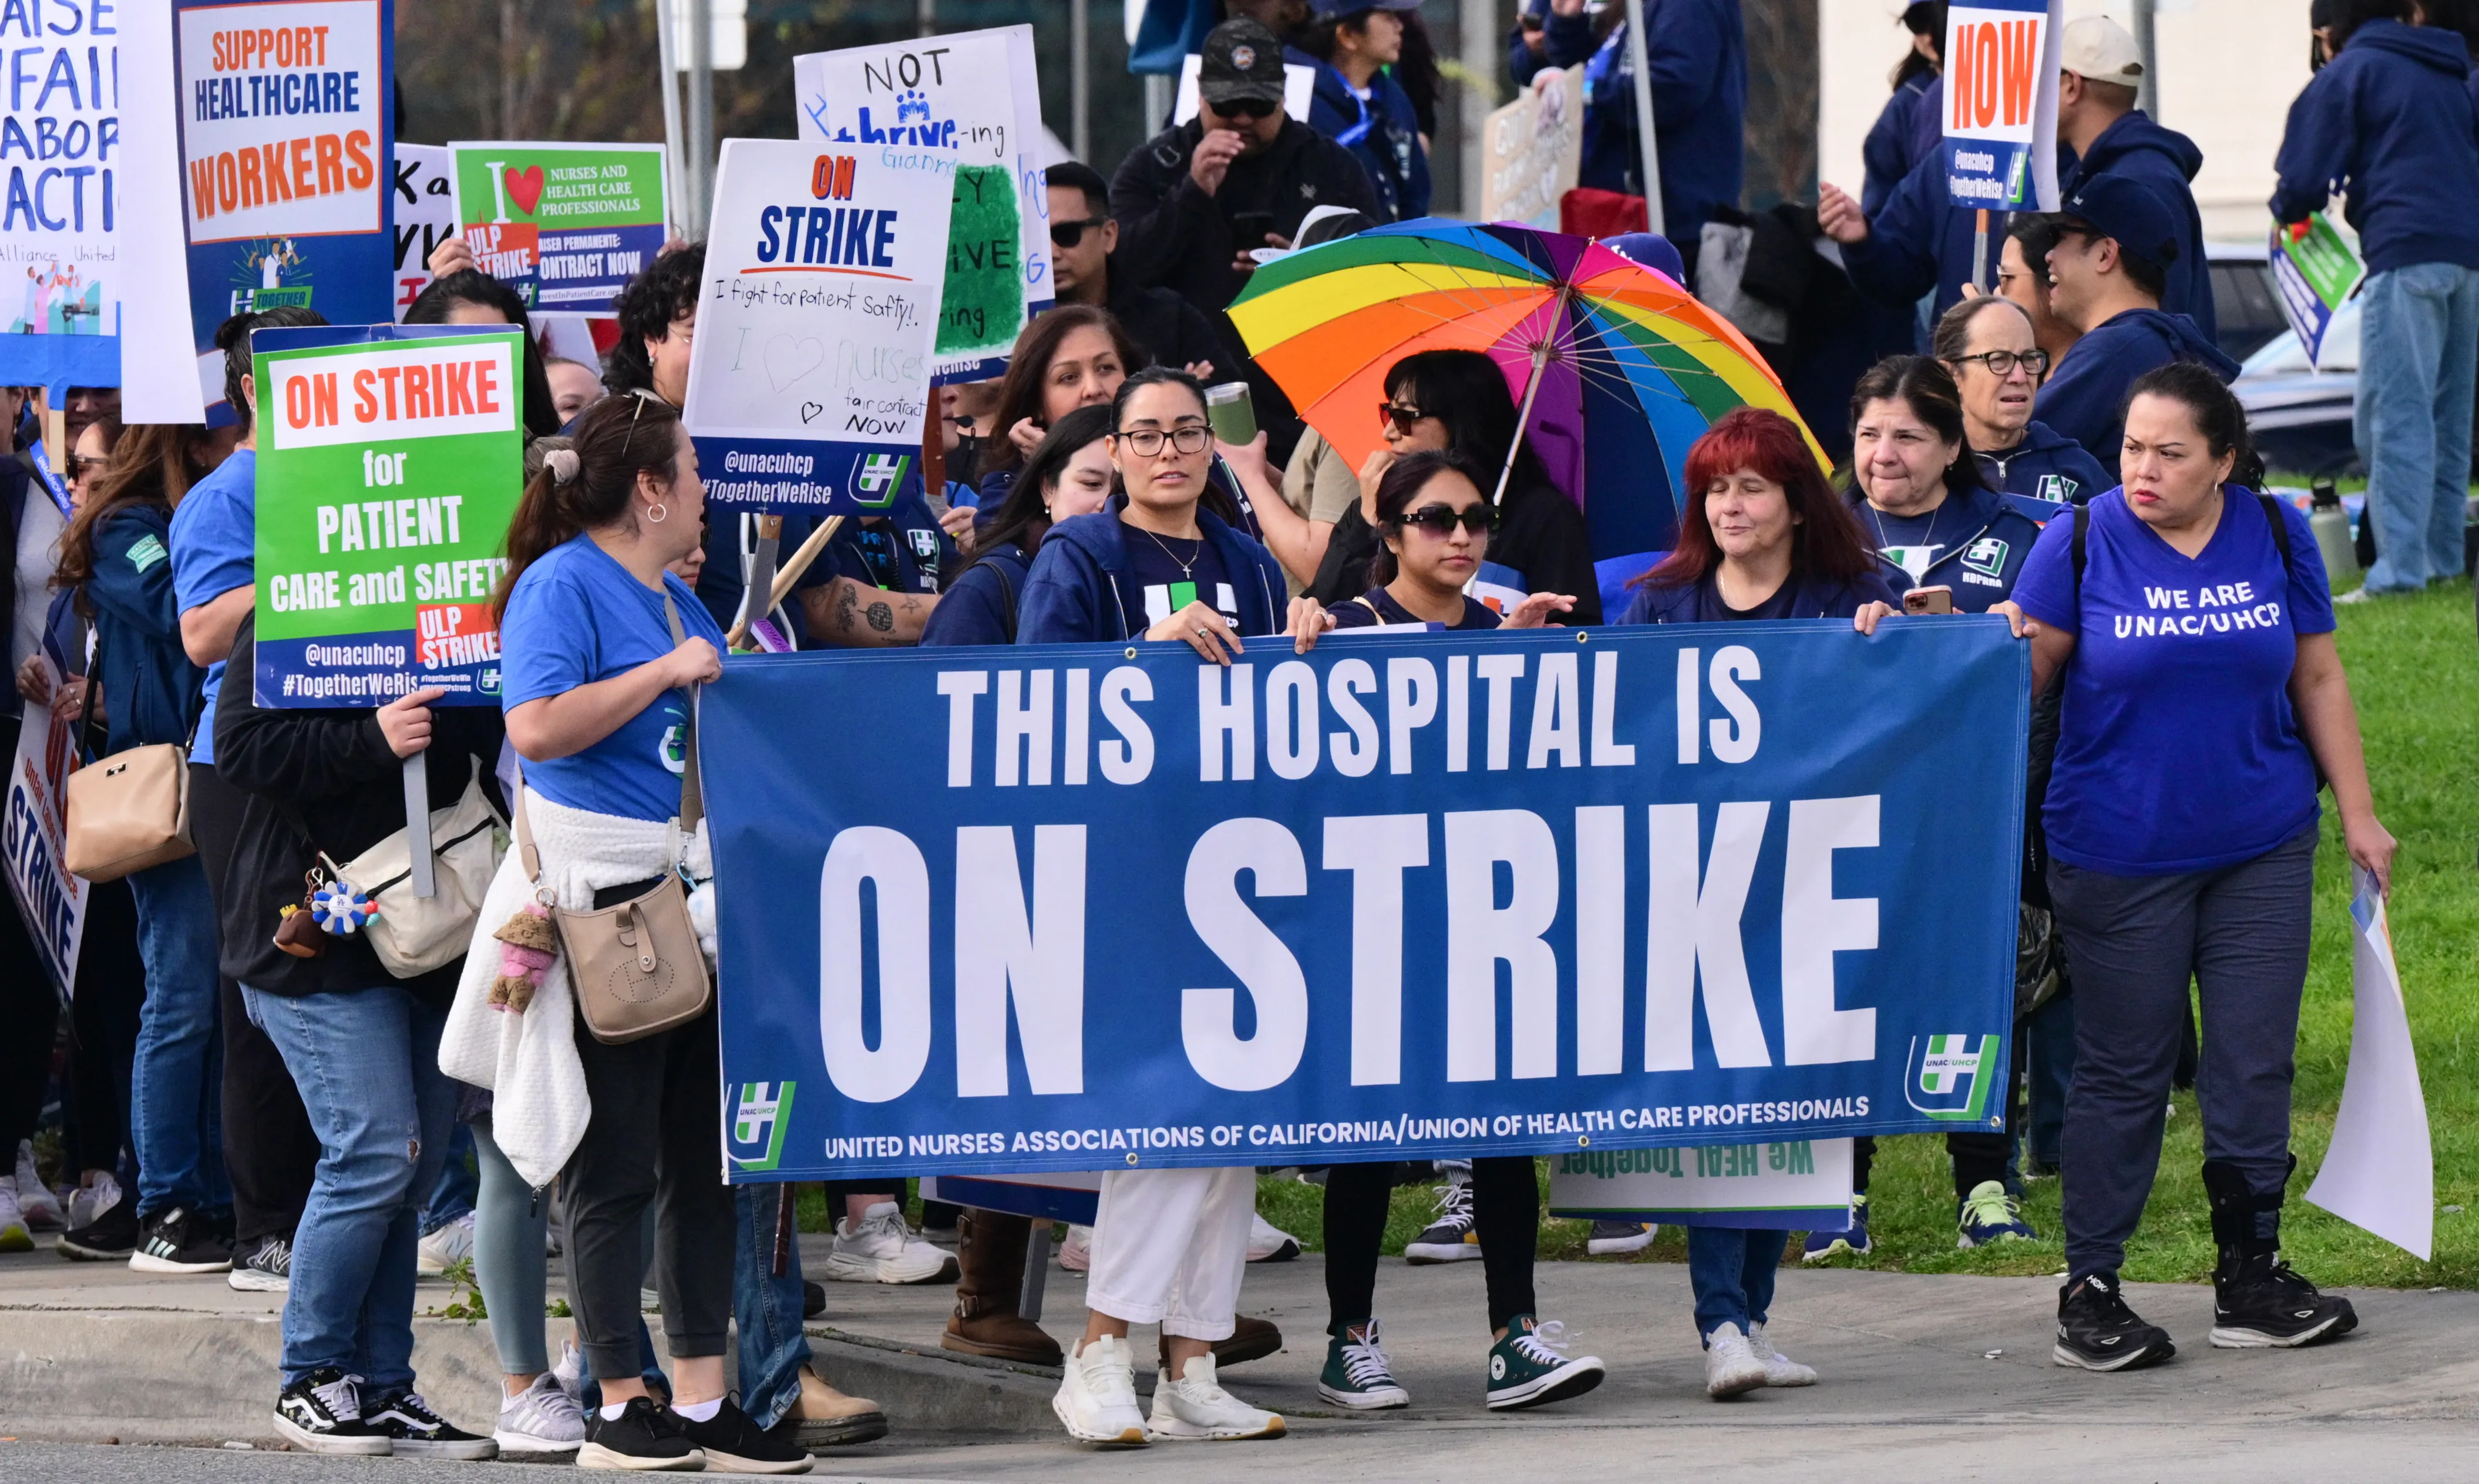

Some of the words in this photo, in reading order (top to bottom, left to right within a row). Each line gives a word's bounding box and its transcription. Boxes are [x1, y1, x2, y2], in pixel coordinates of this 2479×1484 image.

[213, 26, 328, 72] SUPPORT
[0, 46, 117, 112] FAI
[864, 48, 950, 93] NOT
[1953, 19, 2037, 130] NOW
[195, 71, 359, 122] HEALTHCARE
[190, 129, 375, 222] WORKERS
[550, 166, 598, 181] NURSES
[601, 165, 628, 178] AND
[812, 154, 856, 201] ON
[1955, 149, 1994, 174] @unacuhcp
[3, 166, 120, 232] ACTI
[485, 161, 511, 224] I
[541, 198, 640, 216] PROFESSIONALS
[546, 184, 597, 199] HEALTH
[599, 182, 632, 196] CARE
[74, 245, 115, 262] United
[466, 225, 502, 256] ULP
[563, 234, 621, 251] PERMANENTE:
[757, 206, 897, 267] STRIKE
[471, 248, 533, 280] STRIKE
[607, 251, 641, 276] NOW
[257, 291, 306, 308] TOGETHER
[715, 280, 725, 299] I
[731, 279, 768, 308] fight
[773, 281, 796, 304] for
[731, 327, 752, 372] I
[285, 372, 339, 429] ON
[353, 359, 499, 423] STRIKE
[845, 386, 874, 410] fair
[877, 396, 927, 418] contract
[845, 413, 906, 435] NOW
[363, 450, 407, 487] for
[725, 450, 814, 477] @unacuhcp
[702, 479, 832, 504] #TogetherWeRise
[317, 495, 463, 553] PATIENT
[270, 570, 341, 613] CARE
[349, 566, 405, 607] and
[2143, 586, 2191, 610] WE
[2198, 581, 2255, 608] ARE
[419, 606, 462, 640] ULP
[2114, 603, 2280, 639] UNAC/UHCP
[305, 643, 405, 668] @unacuhcp
[422, 631, 501, 670] STRIKE
[936, 666, 1155, 788] THIS
[1198, 651, 1636, 782] HOSPITAL
[1677, 645, 1761, 765] IS
[25, 757, 44, 806] Unfair
[42, 797, 55, 844] Labor
[8, 785, 75, 981] STRIKE
[819, 825, 1088, 1103] ON
[1180, 794, 1882, 1092] STRIKE
[740, 1108, 776, 1116] UNAC/UHCP
[826, 1136, 903, 1159] UNITED
[909, 1132, 1005, 1156] NURSES
[1011, 1126, 1205, 1152] ASSOCIATIONS
[1211, 1125, 1243, 1146] OF
[1249, 1113, 1487, 1145] CALIFORNIA/UNION
[1494, 1115, 1522, 1136] OF
[1527, 1110, 1614, 1135] HEALTH
[1620, 1106, 1683, 1129] CARE
[1688, 1096, 1869, 1126] PROFESSIONALS
[1560, 1147, 1684, 1179] Together
[1691, 1143, 1759, 1177] HEAL
[1768, 1140, 1815, 1175] We
